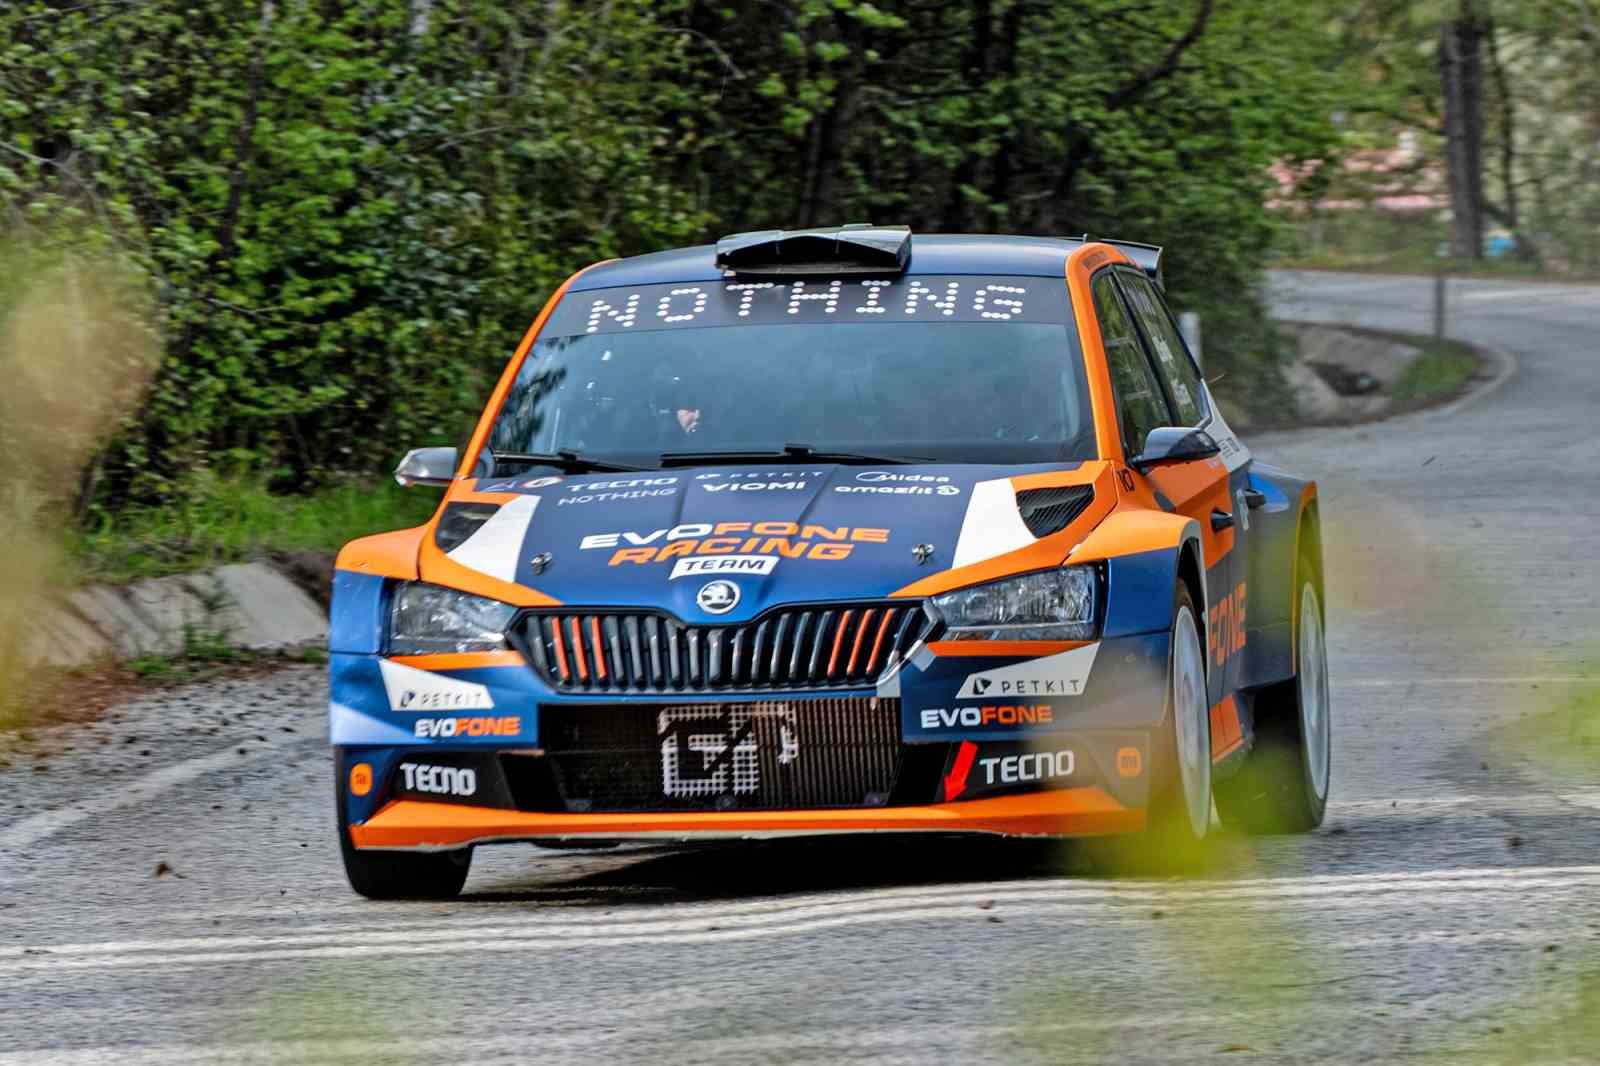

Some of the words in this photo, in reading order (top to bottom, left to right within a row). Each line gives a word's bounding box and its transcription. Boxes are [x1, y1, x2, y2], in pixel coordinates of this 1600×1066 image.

[587, 281, 1025, 332] NOTHING
[567, 477, 679, 492] TECNO
[703, 481, 807, 492] VIOMI
[557, 488, 677, 506] NOTHING
[580, 521, 891, 549] EVOFONE
[608, 538, 854, 566] RACING
[685, 559, 765, 571] TEAM
[1002, 679, 1080, 694] PETKIT
[421, 693, 481, 706] PETKIT
[415, 716, 521, 737] EVOFONE
[920, 704, 1053, 728] EVOFONE
[979, 750, 1075, 784] TECNO
[400, 762, 476, 796] TECNO
